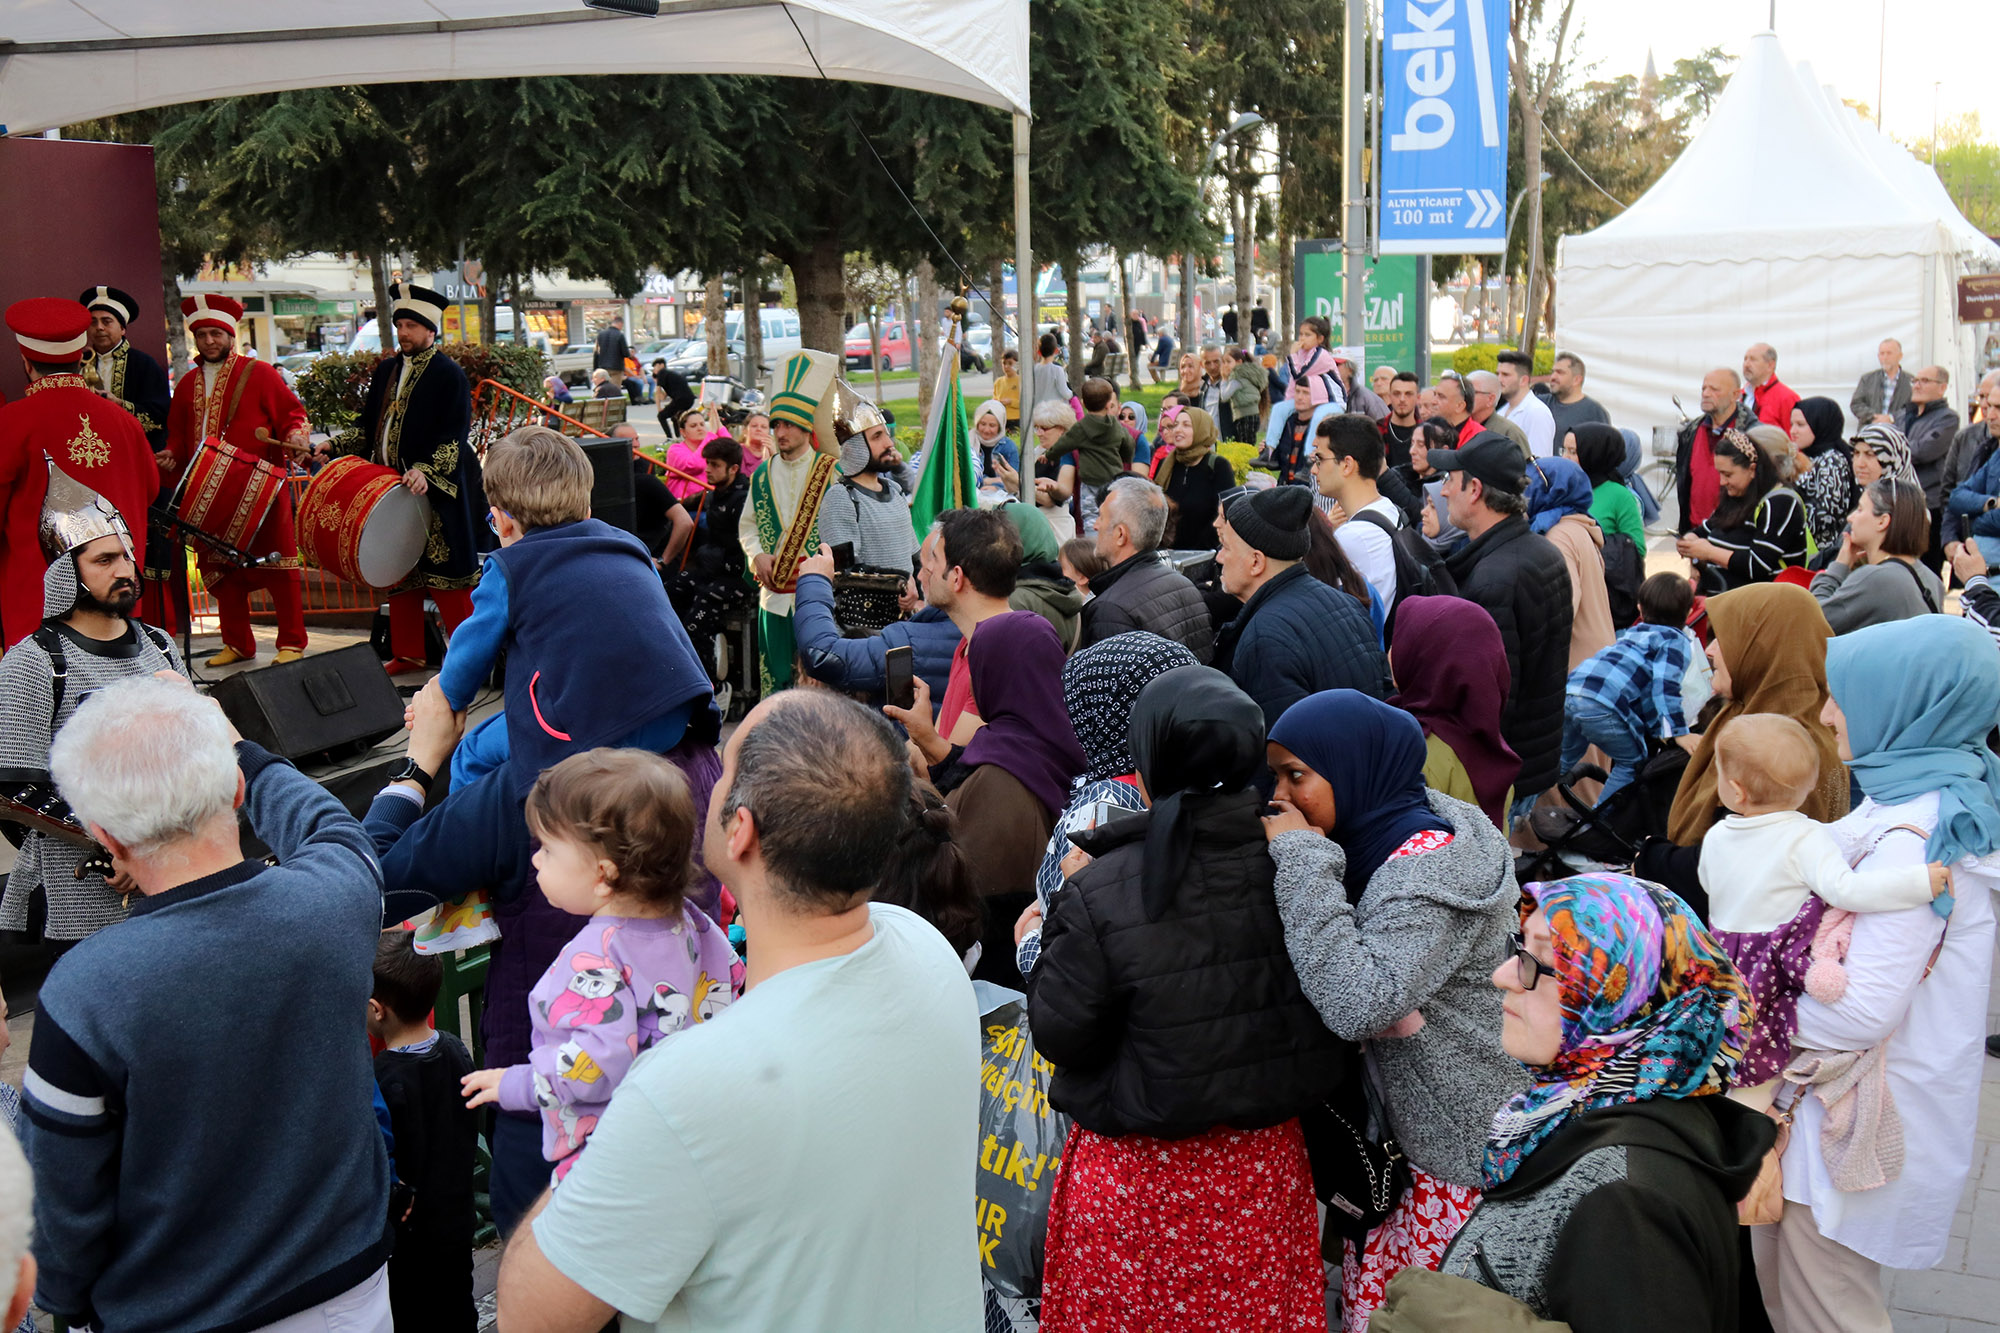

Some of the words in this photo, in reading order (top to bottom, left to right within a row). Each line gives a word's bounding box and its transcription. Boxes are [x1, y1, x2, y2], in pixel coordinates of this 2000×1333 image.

[1391, 0, 1456, 152] bek
[1387, 199, 1417, 208] ALTIN
[1419, 196, 1463, 207] TİCARET
[1392, 209, 1424, 225] 100
[1428, 209, 1454, 224] mt
[1365, 333, 1404, 342] EREKET
